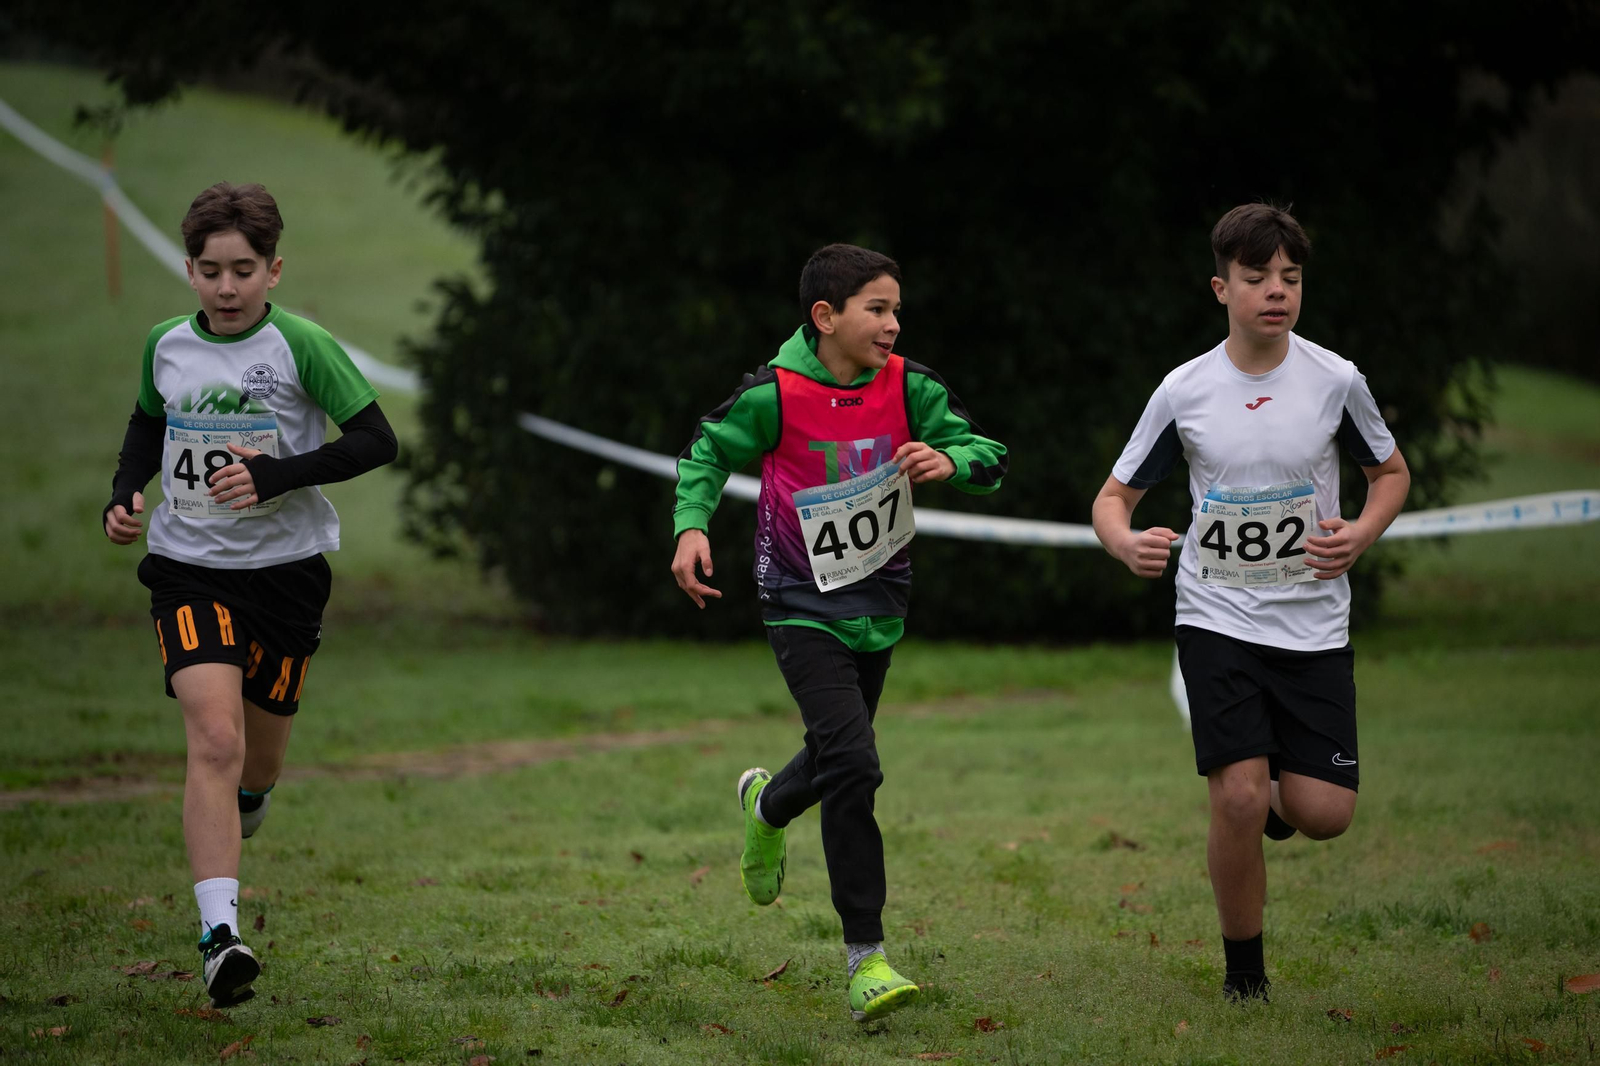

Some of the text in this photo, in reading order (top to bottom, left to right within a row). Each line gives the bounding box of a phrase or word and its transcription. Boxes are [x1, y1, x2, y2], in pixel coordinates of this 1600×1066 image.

[838, 397, 864, 407] OCHO
[174, 411, 217, 421] CAMPIONATO
[194, 421, 214, 429] CROS
[173, 448, 262, 490] 48
[807, 462, 896, 495] CAMPIONATO PROVINCIA
[833, 488, 855, 499] CROS
[856, 470, 888, 491] ESCOLAR
[1221, 490, 1293, 502] DE CROS ESCOLAR
[820, 508, 842, 516] GALICIA
[812, 488, 900, 560] 407
[1200, 516, 1306, 562] 482
